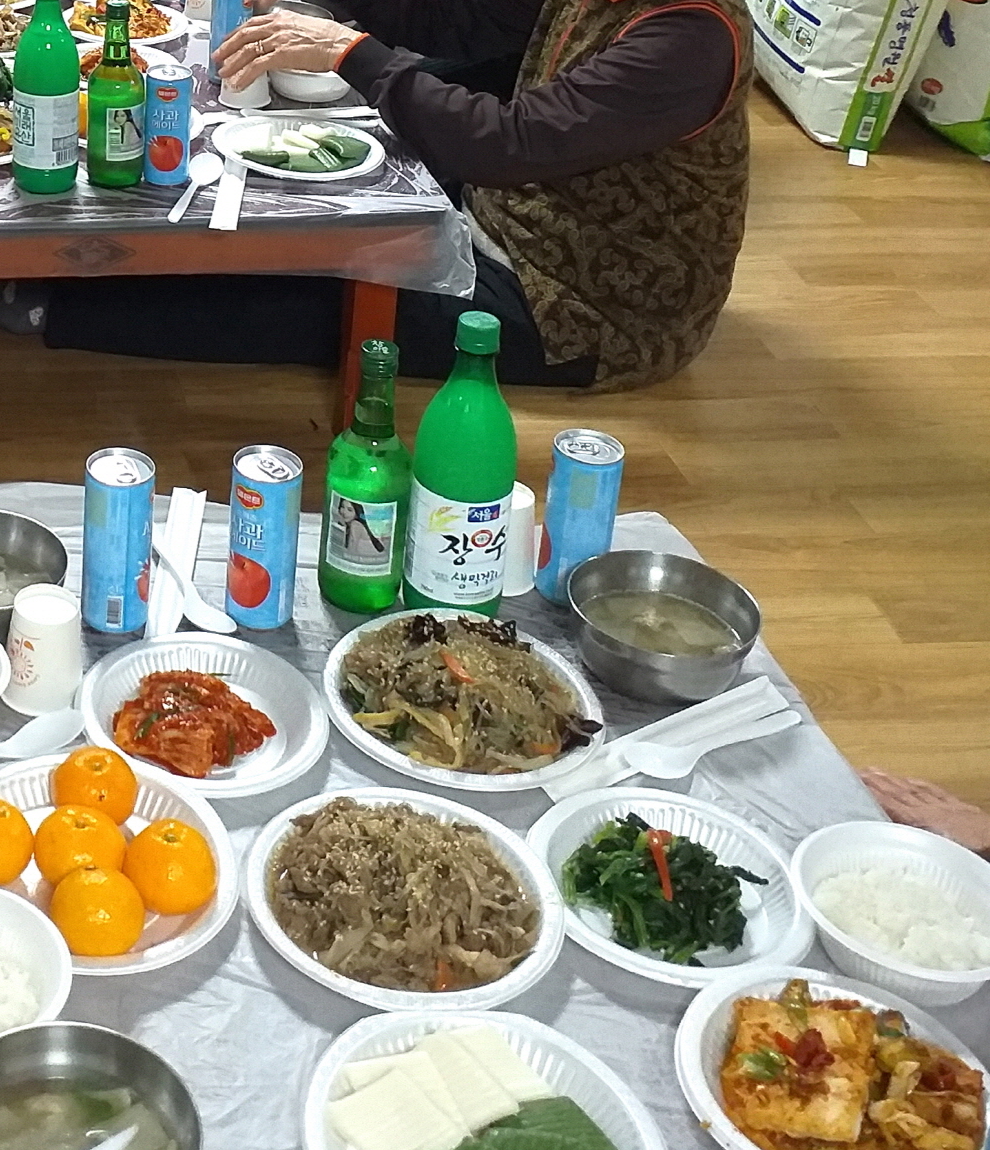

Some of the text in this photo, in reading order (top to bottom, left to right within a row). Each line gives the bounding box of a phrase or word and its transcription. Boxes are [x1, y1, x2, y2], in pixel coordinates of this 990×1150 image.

[153, 109, 179, 121] 사과
[152, 120, 180, 130] 에이드
[471, 508, 493, 521] 서울
[438, 525, 507, 566] 장수
[451, 570, 499, 590] 생막걸리
